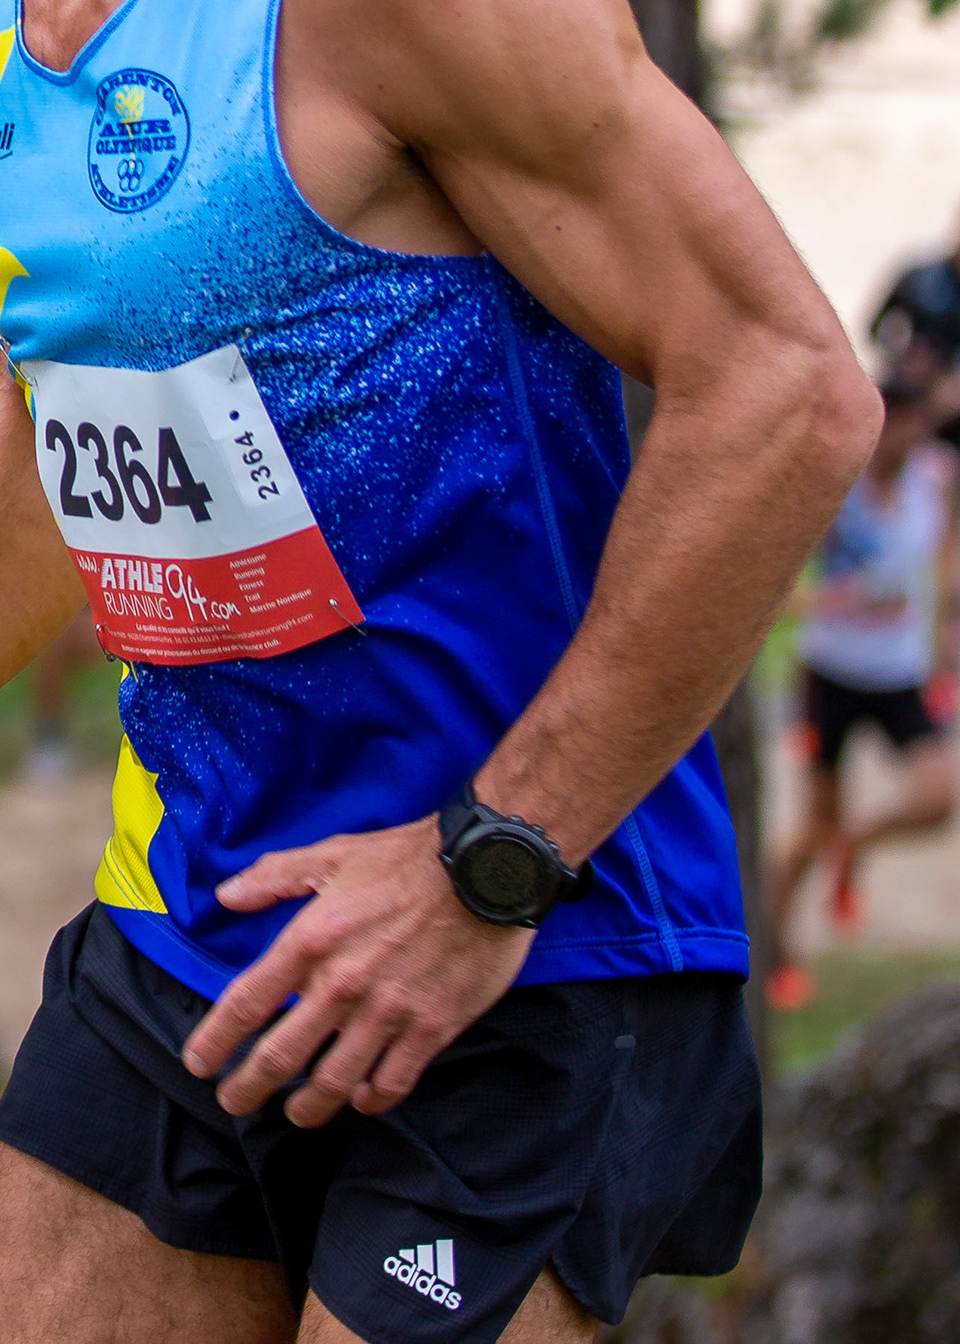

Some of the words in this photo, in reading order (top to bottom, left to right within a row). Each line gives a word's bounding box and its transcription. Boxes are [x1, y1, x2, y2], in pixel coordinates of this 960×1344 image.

[45, 419, 213, 525] 2364
[235, 430, 279, 500] 2364
[101, 558, 163, 594] ATHLE
[234, 567, 265, 581] Running
[239, 580, 264, 592] Fitness
[103, 591, 174, 621] RUNNING
[244, 593, 261, 603] Trail
[249, 598, 276, 614] Marche
[276, 588, 312, 606] Nordique
[383, 1256, 462, 1310] adidas
